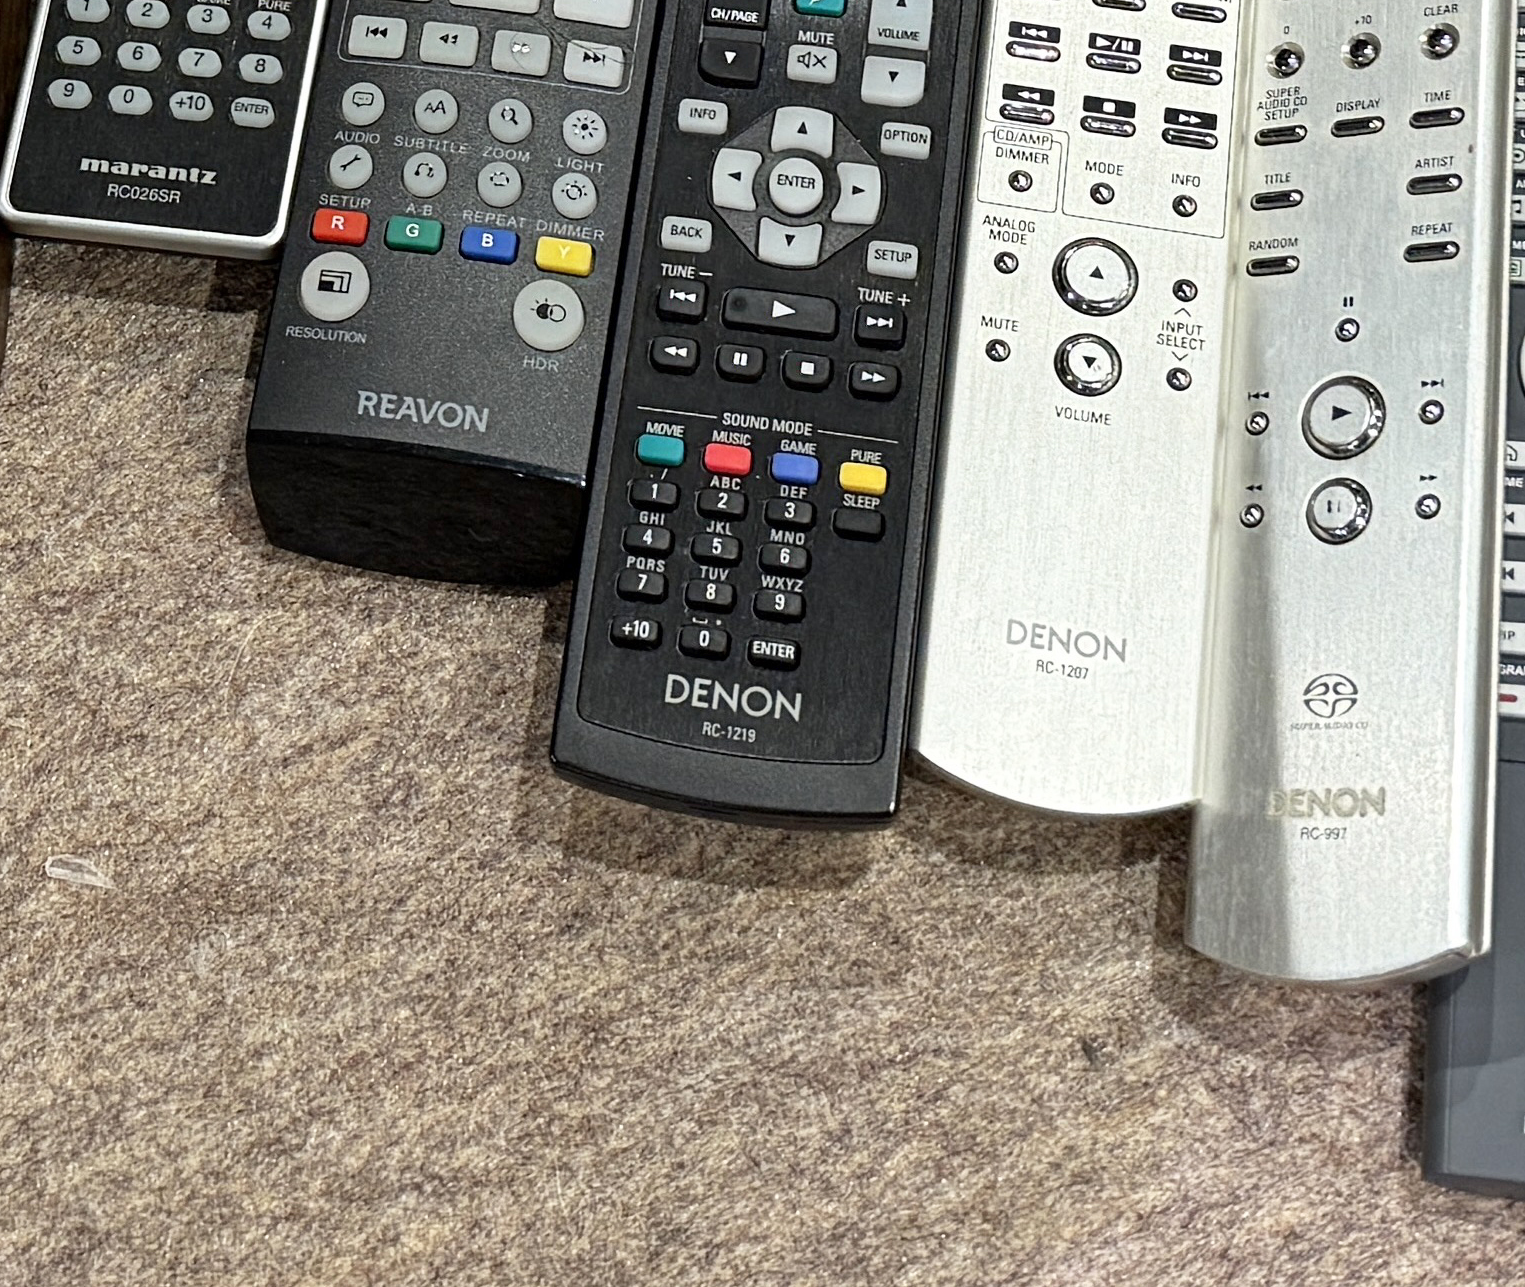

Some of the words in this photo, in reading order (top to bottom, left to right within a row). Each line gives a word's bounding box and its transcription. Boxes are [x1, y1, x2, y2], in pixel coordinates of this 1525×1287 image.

[142, 3, 153, 17] 2
[258, 0, 292, 12] PURE
[1423, 4, 1458, 17] CLEAR
[201, 9, 213, 23] 3
[261, 16, 272, 30] 4
[797, 30, 834, 45] MUTE
[877, 28, 920, 41] VOLUME
[73, 40, 84, 54] 5
[132, 46, 144, 60] 6
[175, 95, 206, 111] +10
[234, 103, 269, 115] ENTER
[1336, 99, 1381, 113] DISPLAY
[334, 130, 380, 145] AUDIO
[394, 135, 469, 154] SUBTITLE
[883, 129, 929, 145] OPTION
[997, 129, 1049, 146] CD/AMP
[482, 146, 531, 162] ZOOM
[995, 147, 1050, 165] DIMMER
[557, 157, 605, 173] LIGHT
[1085, 160, 1124, 176] MODE
[1415, 156, 1454, 169] ARTIST
[80, 157, 217, 186] marantz
[1264, 173, 1291, 185] TITLE
[777, 174, 816, 190] ENTER
[107, 183, 182, 204] RC026SR
[319, 194, 372, 209] SETUP
[331, 216, 345, 231] R
[463, 209, 527, 227] REPEAT
[982, 215, 1036, 233] ANALOG
[405, 224, 419, 238] G
[537, 220, 605, 241] DIMMER
[670, 225, 703, 239] BACK
[1411, 223, 1453, 236] REPEAT
[482, 233, 494, 248] B
[1249, 238, 1299, 251] RANDOM
[874, 248, 912, 263] SETUP
[980, 316, 1019, 332] MUTE
[285, 325, 367, 345] RESOLUTION
[523, 356, 559, 372] HDR
[358, 389, 489, 433] REAVON
[1055, 406, 1112, 426] VOLUME
[646, 421, 685, 436] MOVIE
[722, 412, 770, 430] SOUND
[772, 418, 813, 436] MODE
[712, 430, 751, 446] MUSIC
[780, 439, 816, 455] GAME
[851, 449, 882, 464] PURE
[710, 476, 741, 490] ABC
[780, 485, 808, 498] DEF
[843, 493, 880, 509] SLEEP
[626, 556, 666, 573] PQRS
[762, 575, 804, 593] WXYZ
[1007, 618, 1127, 663] DENON
[752, 641, 796, 659] ENTER
[1036, 659, 1089, 679] RC-1207
[665, 673, 802, 722] DENON
[702, 722, 757, 744] RC-1219
[1268, 786, 1386, 818] DENON
